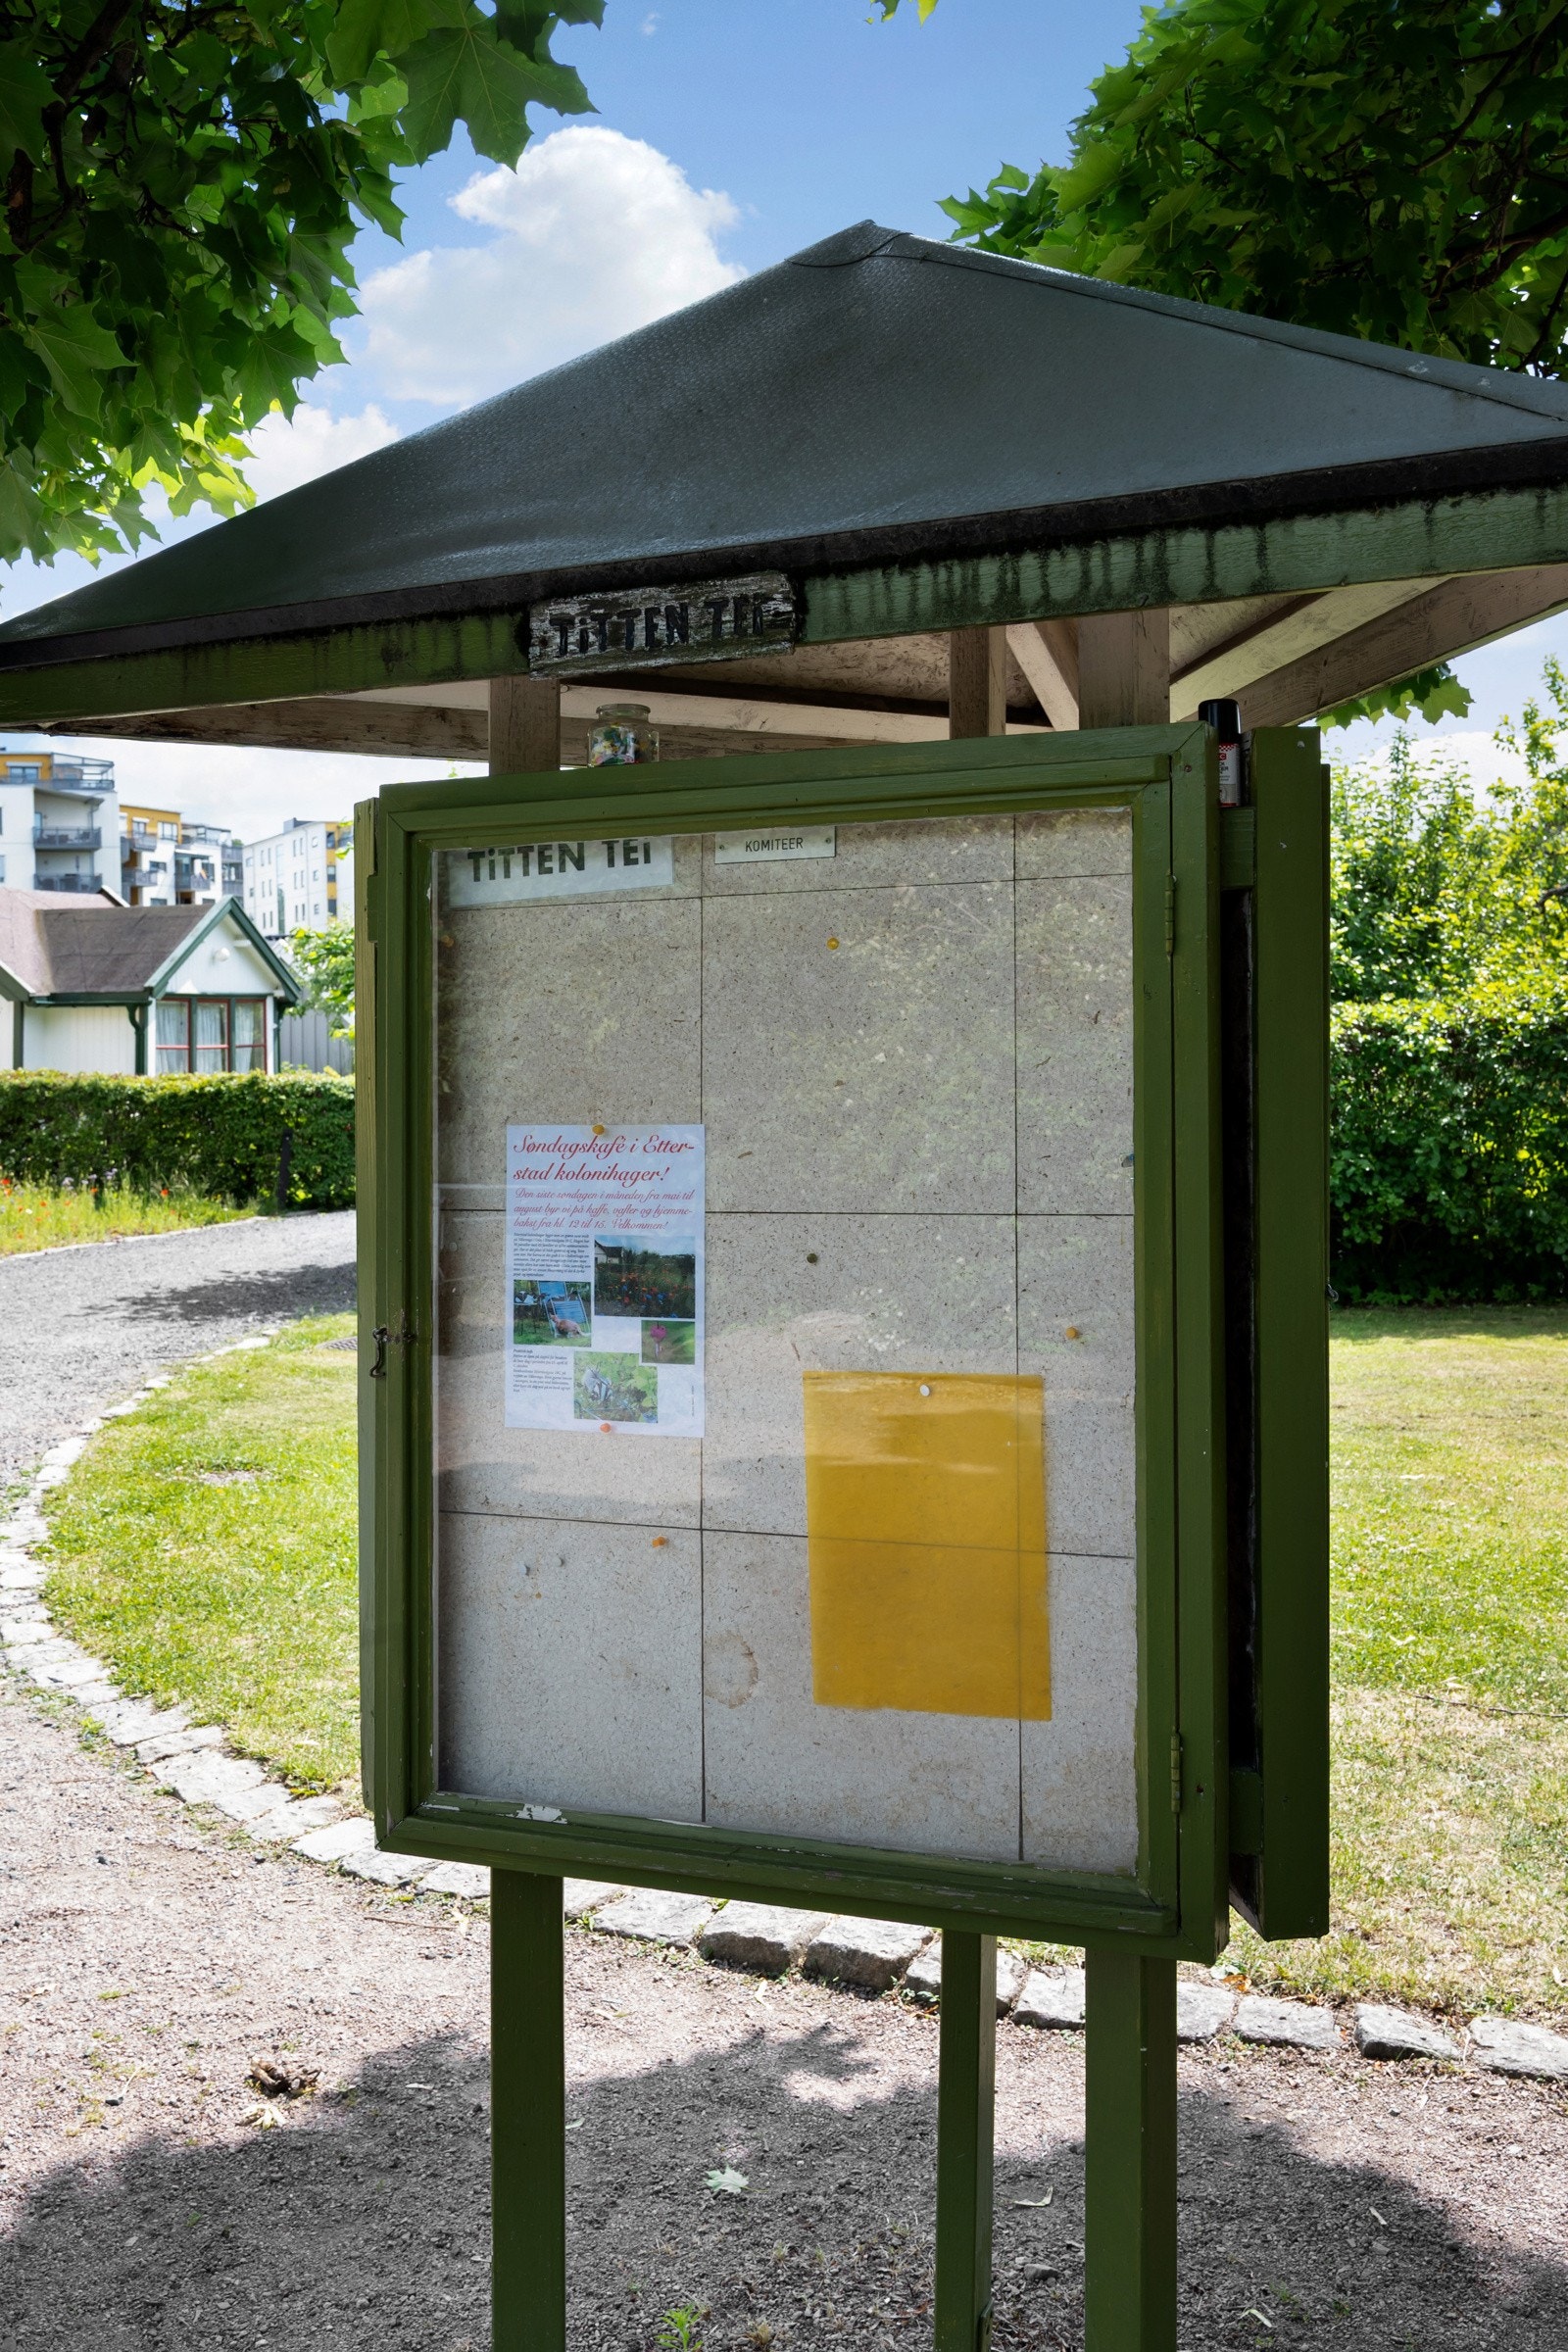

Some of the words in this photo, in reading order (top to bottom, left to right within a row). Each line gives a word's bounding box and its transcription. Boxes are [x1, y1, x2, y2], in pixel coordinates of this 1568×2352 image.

[745, 838, 804, 853] KOMITEER
[467, 842, 585, 882] TiTTEN
[629, 1138, 640, 1153] i
[642, 1134, 695, 1153] Etter-
[513, 1162, 555, 1181] stad
[554, 1162, 670, 1188] kolonihager!
[515, 1188, 534, 1199] Den
[536, 1190, 555, 1199] siste
[639, 1189, 660, 1203] fra
[662, 1191, 680, 1200] mai
[681, 1189, 696, 1200] til
[514, 1205, 543, 1215] august
[543, 1202, 561, 1216] byr
[569, 1204, 585, 1217] på
[612, 1203, 638, 1217] vafler
[639, 1208, 653, 1218] og
[652, 1203, 692, 1218] hjemme-
[514, 1216, 538, 1228] bakst
[532, 1217, 552, 1231] fra
[568, 1219, 580, 1228] 12
[580, 1217, 594, 1229] til
[612, 1218, 669, 1230] Velkommen!
